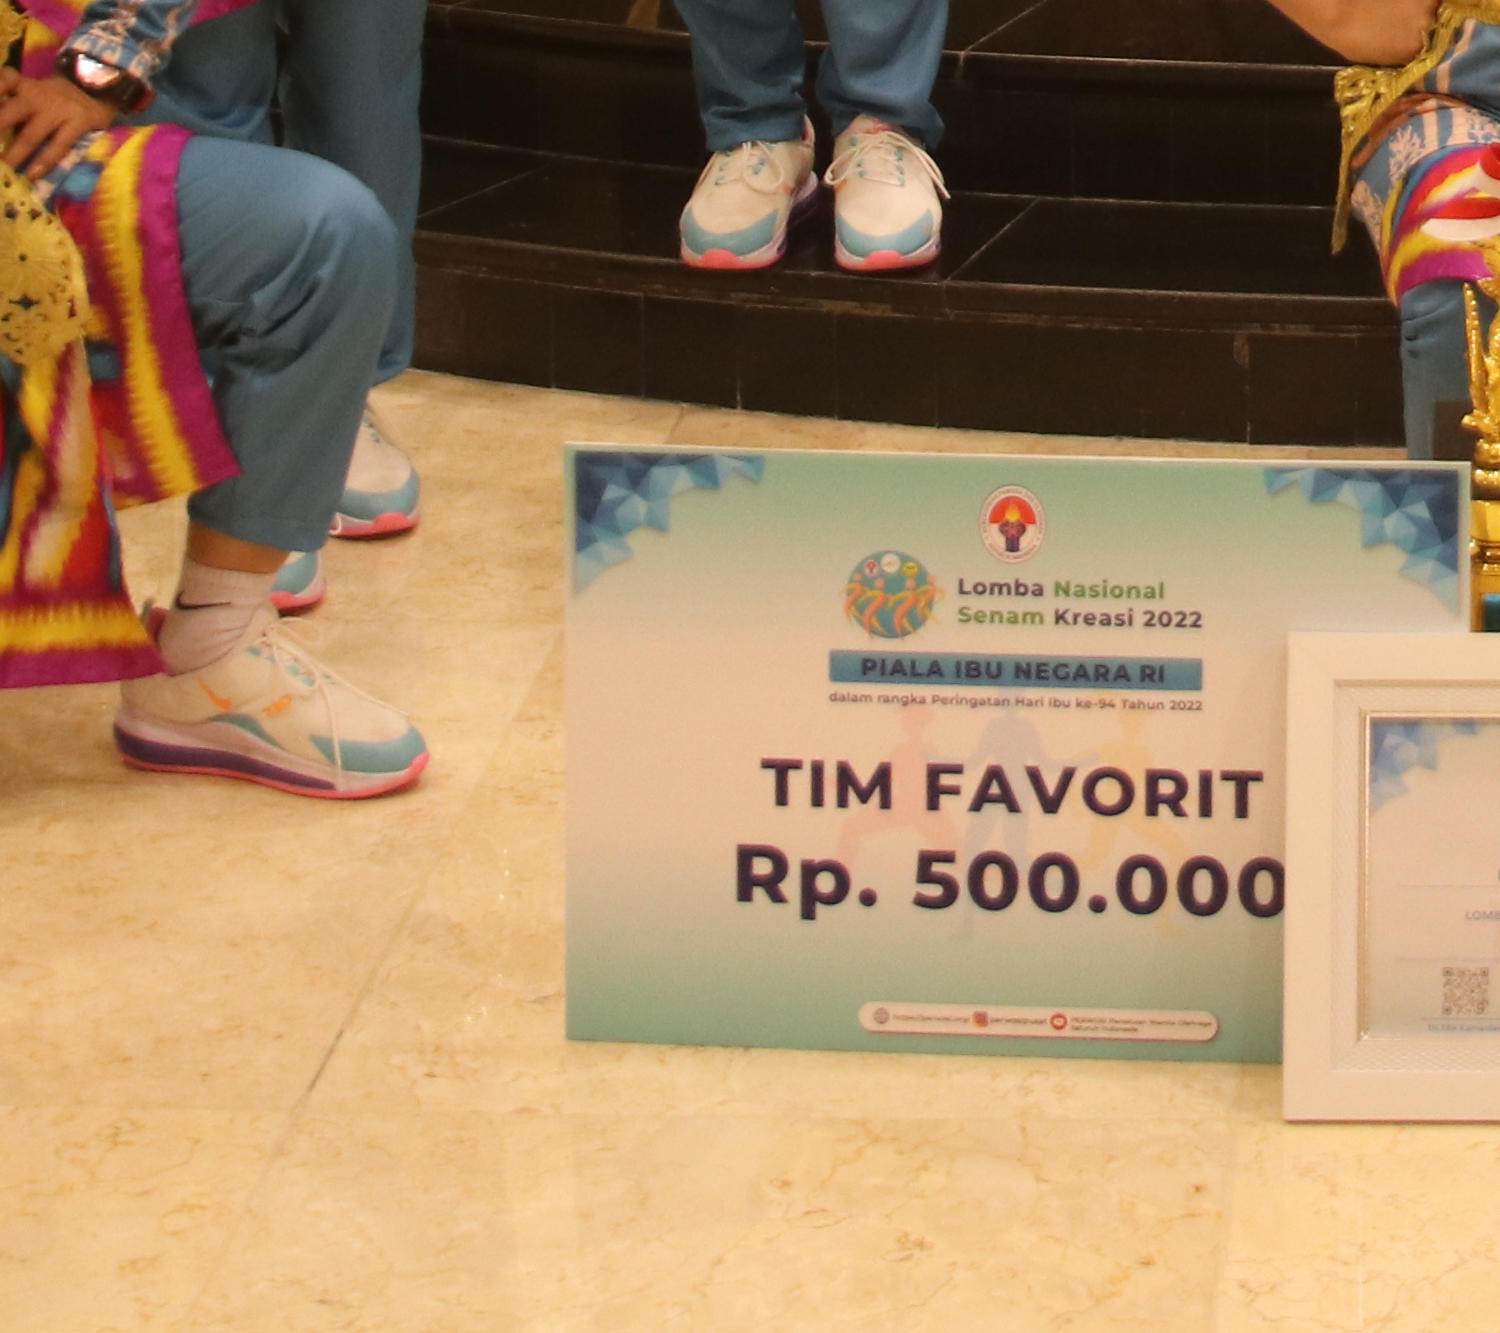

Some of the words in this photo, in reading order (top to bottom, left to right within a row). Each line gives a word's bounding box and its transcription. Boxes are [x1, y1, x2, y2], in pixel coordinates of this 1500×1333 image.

[957, 578, 1045, 598] Lomba
[1053, 580, 1165, 600] Nasional
[957, 606, 1045, 625] Senam
[1053, 607, 1134, 627] Kreasi
[1142, 610, 1203, 628] 2022
[860, 657, 945, 679] PIALA
[954, 659, 1002, 680] IBU
[1013, 661, 1132, 683] NEGARA
[1139, 664, 1166, 684] RI
[829, 691, 873, 704] dalam
[877, 693, 927, 707] rangka
[932, 693, 1011, 709] Peringatan
[1015, 696, 1043, 708] Hari
[1048, 697, 1071, 709] Ibu
[1121, 699, 1165, 710] Tahun
[1169, 700, 1203, 711] 2022
[760, 757, 894, 811] TIM
[924, 763, 1265, 820] FAVORIT
[733, 843, 877, 922] Rp.
[911, 850, 1286, 919] 500.000
